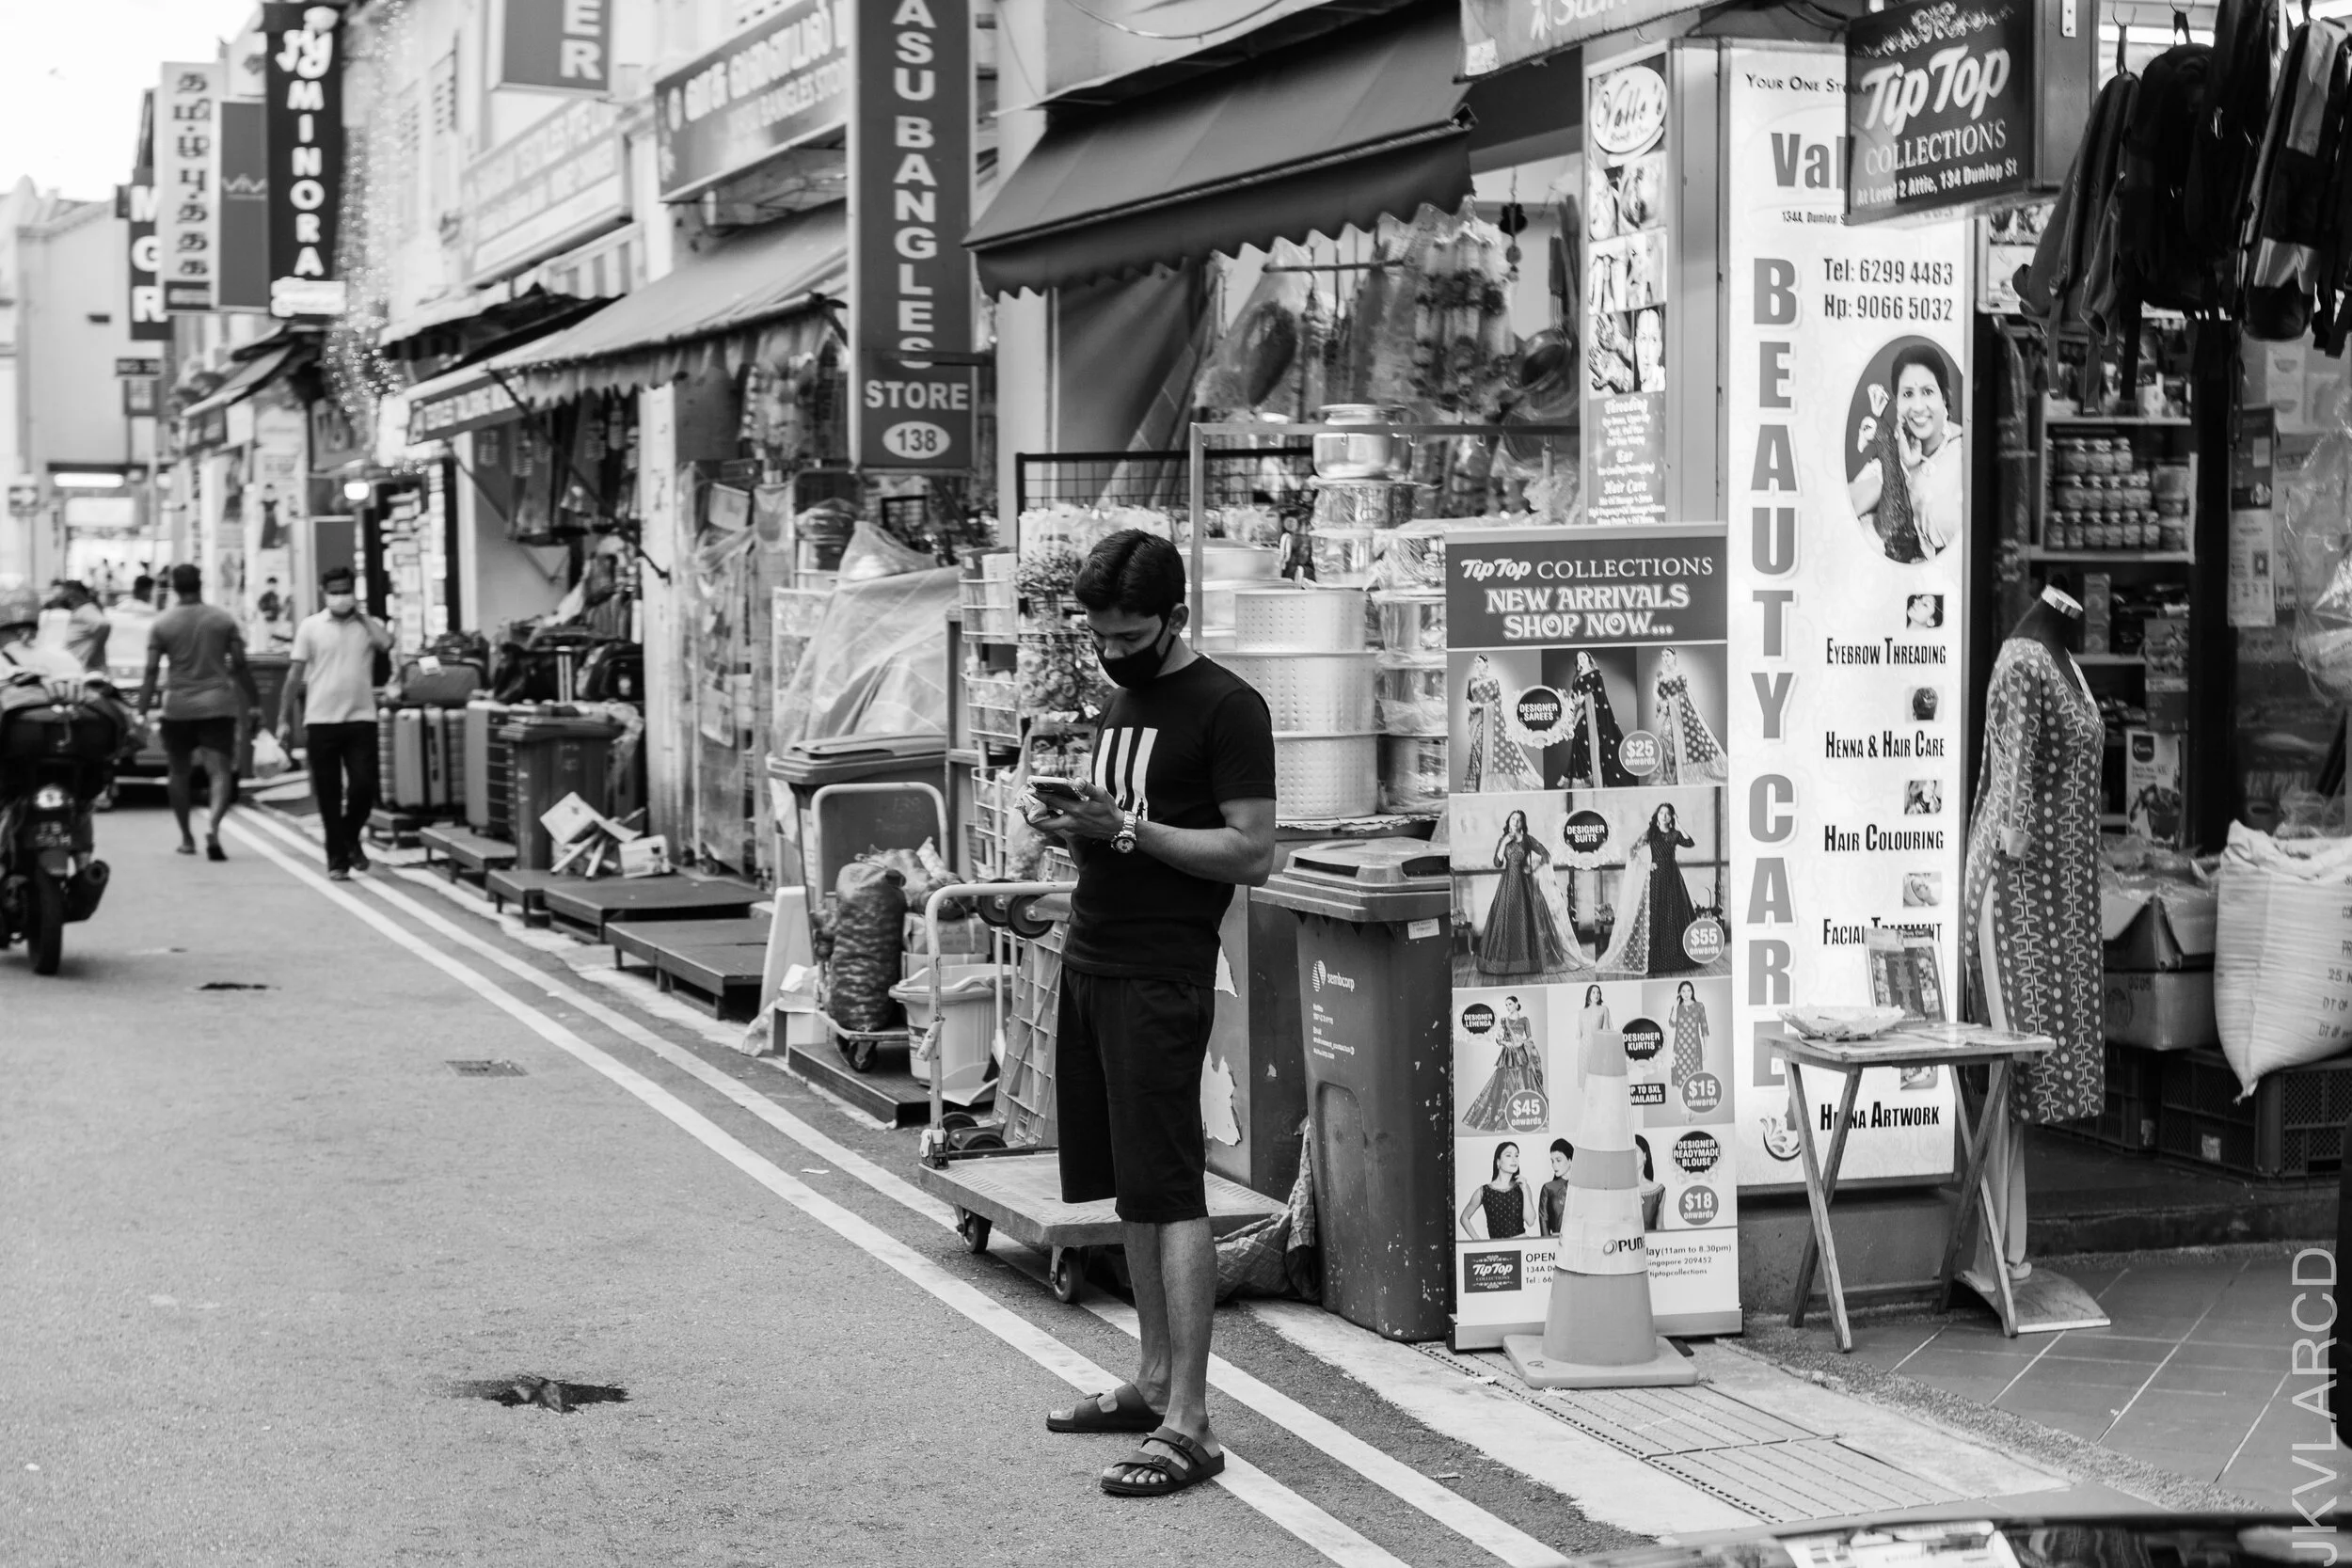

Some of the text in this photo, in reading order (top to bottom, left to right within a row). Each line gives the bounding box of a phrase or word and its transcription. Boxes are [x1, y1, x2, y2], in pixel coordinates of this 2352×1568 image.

[560, 0, 603, 81] ER
[1861, 43, 2010, 136] Tip Top
[1865, 119, 2007, 176] COLLECTIONS
[1771, 132, 1847, 189] Val
[1857, 158, 2018, 206] At Level 2 Attic, 134 Dunlop St
[894, 116, 937, 369] BANGLES
[1823, 258, 1953, 285] Tel: 6299 4483
[1824, 293, 1953, 322] Hp: 9066 5032
[865, 379, 968, 411] STORE
[896, 428, 938, 452] 138
[1751, 257, 1797, 738] BEAUTY
[1460, 557, 1713, 581] Tip Top COLLECTIONS
[1485, 582, 1690, 614] NEW ARRIVALS
[1504, 612, 1674, 640] SHOP NOW...
[1518, 702, 1558, 714] DESIGNER
[1523, 711, 1554, 722] SAREES
[1626, 739, 1654, 758] $25
[1867, 735, 1878, 757] &
[1625, 756, 1656, 767] onwards
[1566, 824, 1605, 835] DESIGNER
[1574, 832, 1600, 844] SUITS
[1692, 927, 1718, 946] $55
[1689, 946, 1719, 956] onwards
[1327, 972, 1355, 992] sembcorp
[1464, 1013, 1493, 1022] DESIGNER
[1623, 1032, 1661, 1042] DESIGNER
[1628, 1041, 1655, 1051] KURTIS
[1689, 1080, 1716, 1098] $15
[1630, 1094, 1663, 1103] VAILABLE
[1687, 1098, 1717, 1107] onwards
[1512, 1099, 1540, 1117] $45
[1511, 1117, 1542, 1126] onwards
[1820, 1104, 1866, 1131] HNA
[1673, 1148, 1720, 1158] READYMADE
[1677, 1140, 1715, 1150] DESIGNER
[1682, 1158, 1711, 1167] BLOUSE
[1684, 1192, 1712, 1212] $18
[1684, 1211, 1713, 1220] onwards
[1525, 1252, 1555, 1262] OPEN
[1472, 1262, 1513, 1276] Tip Top
